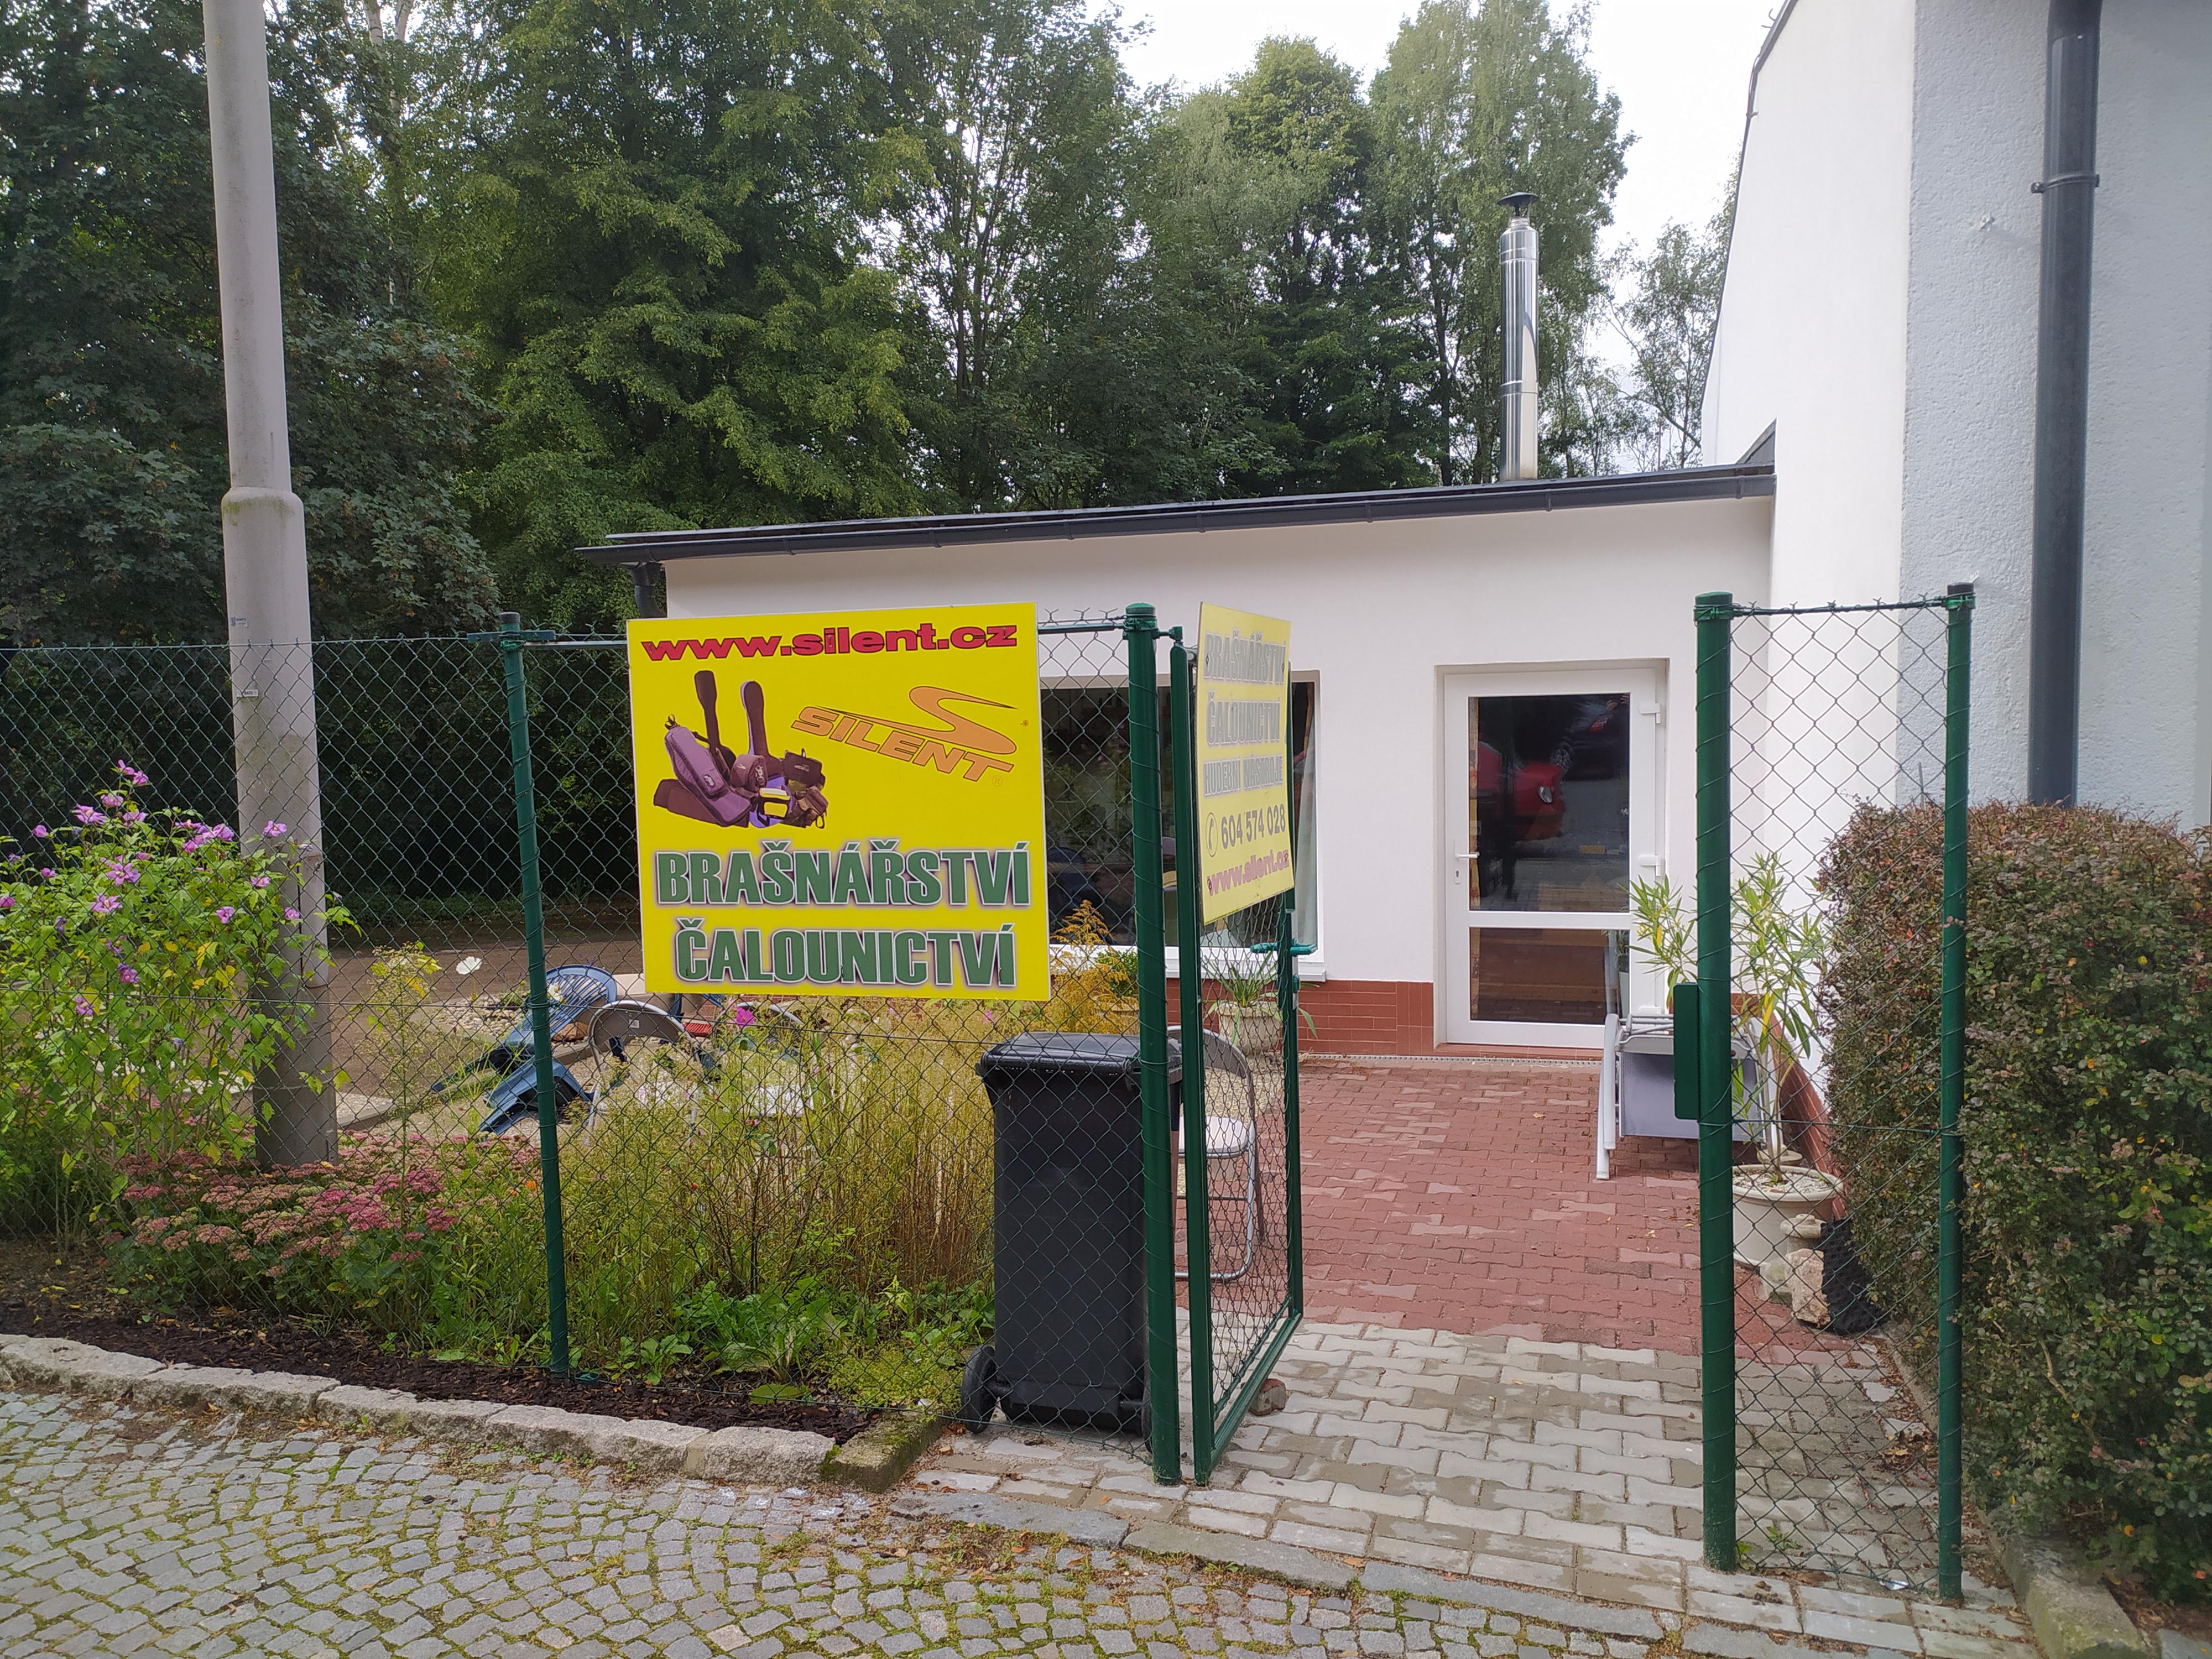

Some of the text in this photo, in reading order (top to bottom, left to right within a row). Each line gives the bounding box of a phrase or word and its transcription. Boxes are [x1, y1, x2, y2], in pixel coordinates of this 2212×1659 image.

[641, 623, 1018, 661] www.silent.cz
[791, 706, 1015, 782] SILENT
[1206, 690, 1281, 747] ČALOUNICTVÍ
[1221, 804, 1286, 849] 604 574 028
[655, 839, 1030, 905] BRAŠNÁŘSTVÍ
[675, 918, 1016, 987] ČALOUNICTVÍ
